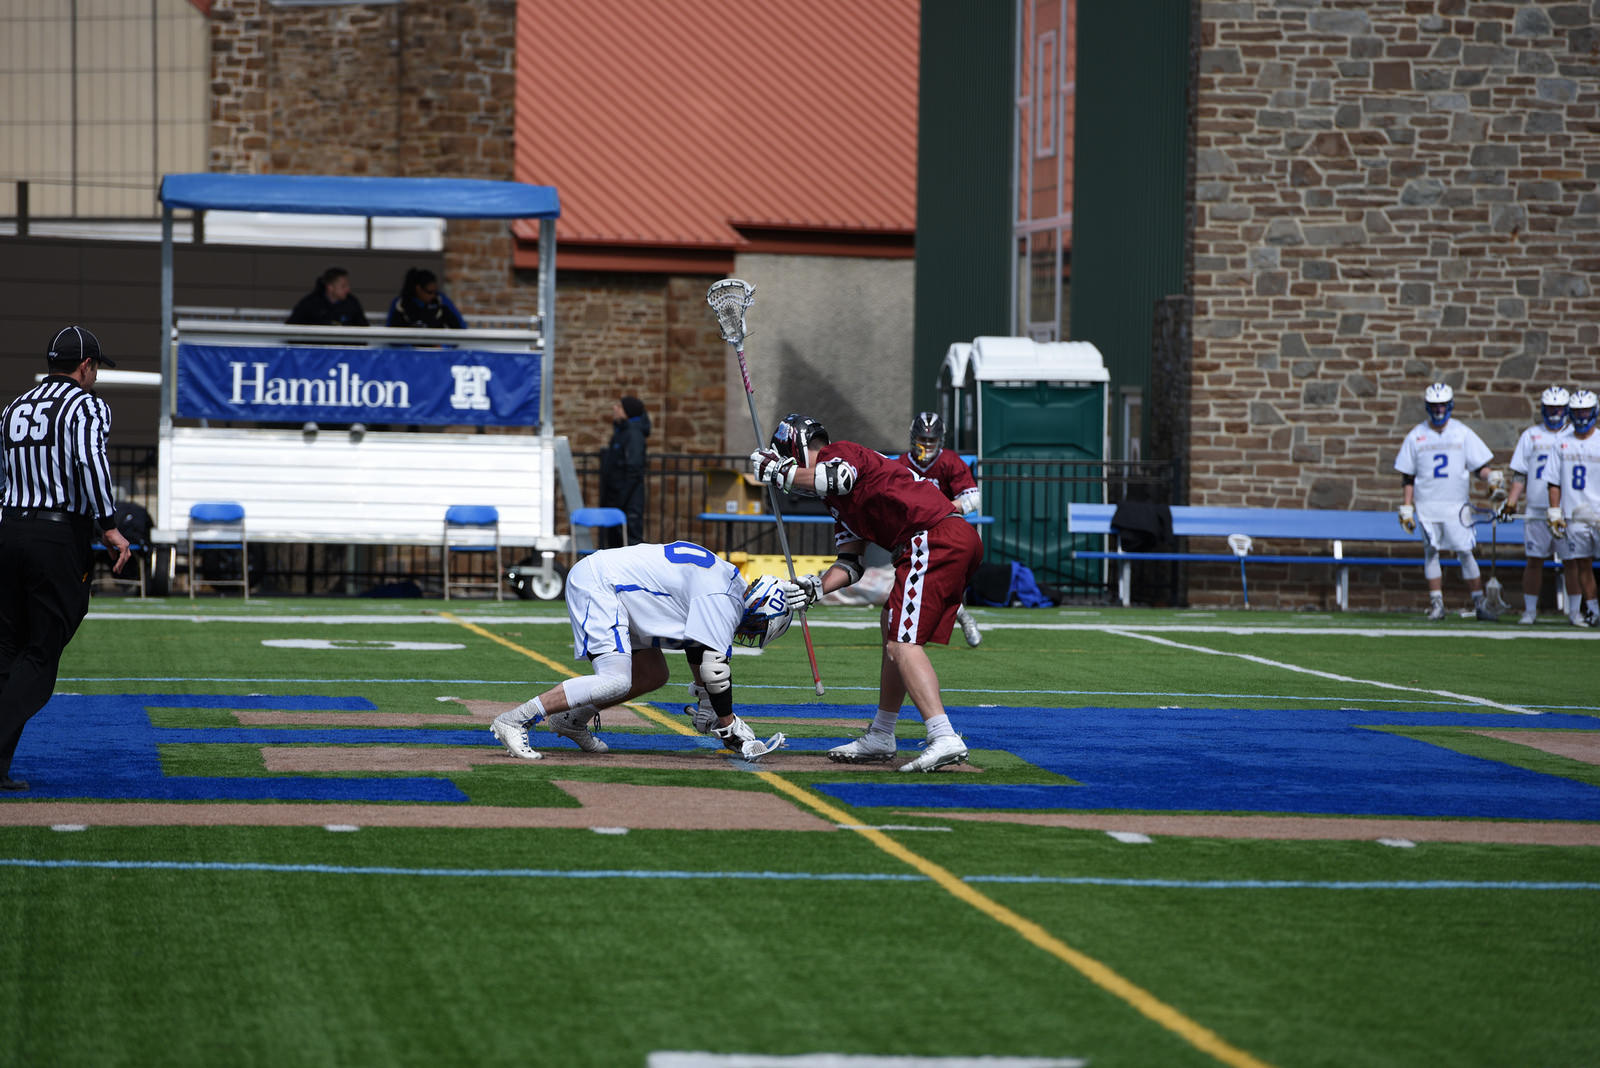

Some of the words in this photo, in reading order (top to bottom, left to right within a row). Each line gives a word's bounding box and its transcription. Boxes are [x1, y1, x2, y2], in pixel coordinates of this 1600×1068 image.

[227, 361, 411, 409] Hamilton
[449, 364, 492, 411] H
[9, 401, 54, 442] 65
[1432, 453, 1449, 478] 2
[1572, 465, 1587, 491] 8
